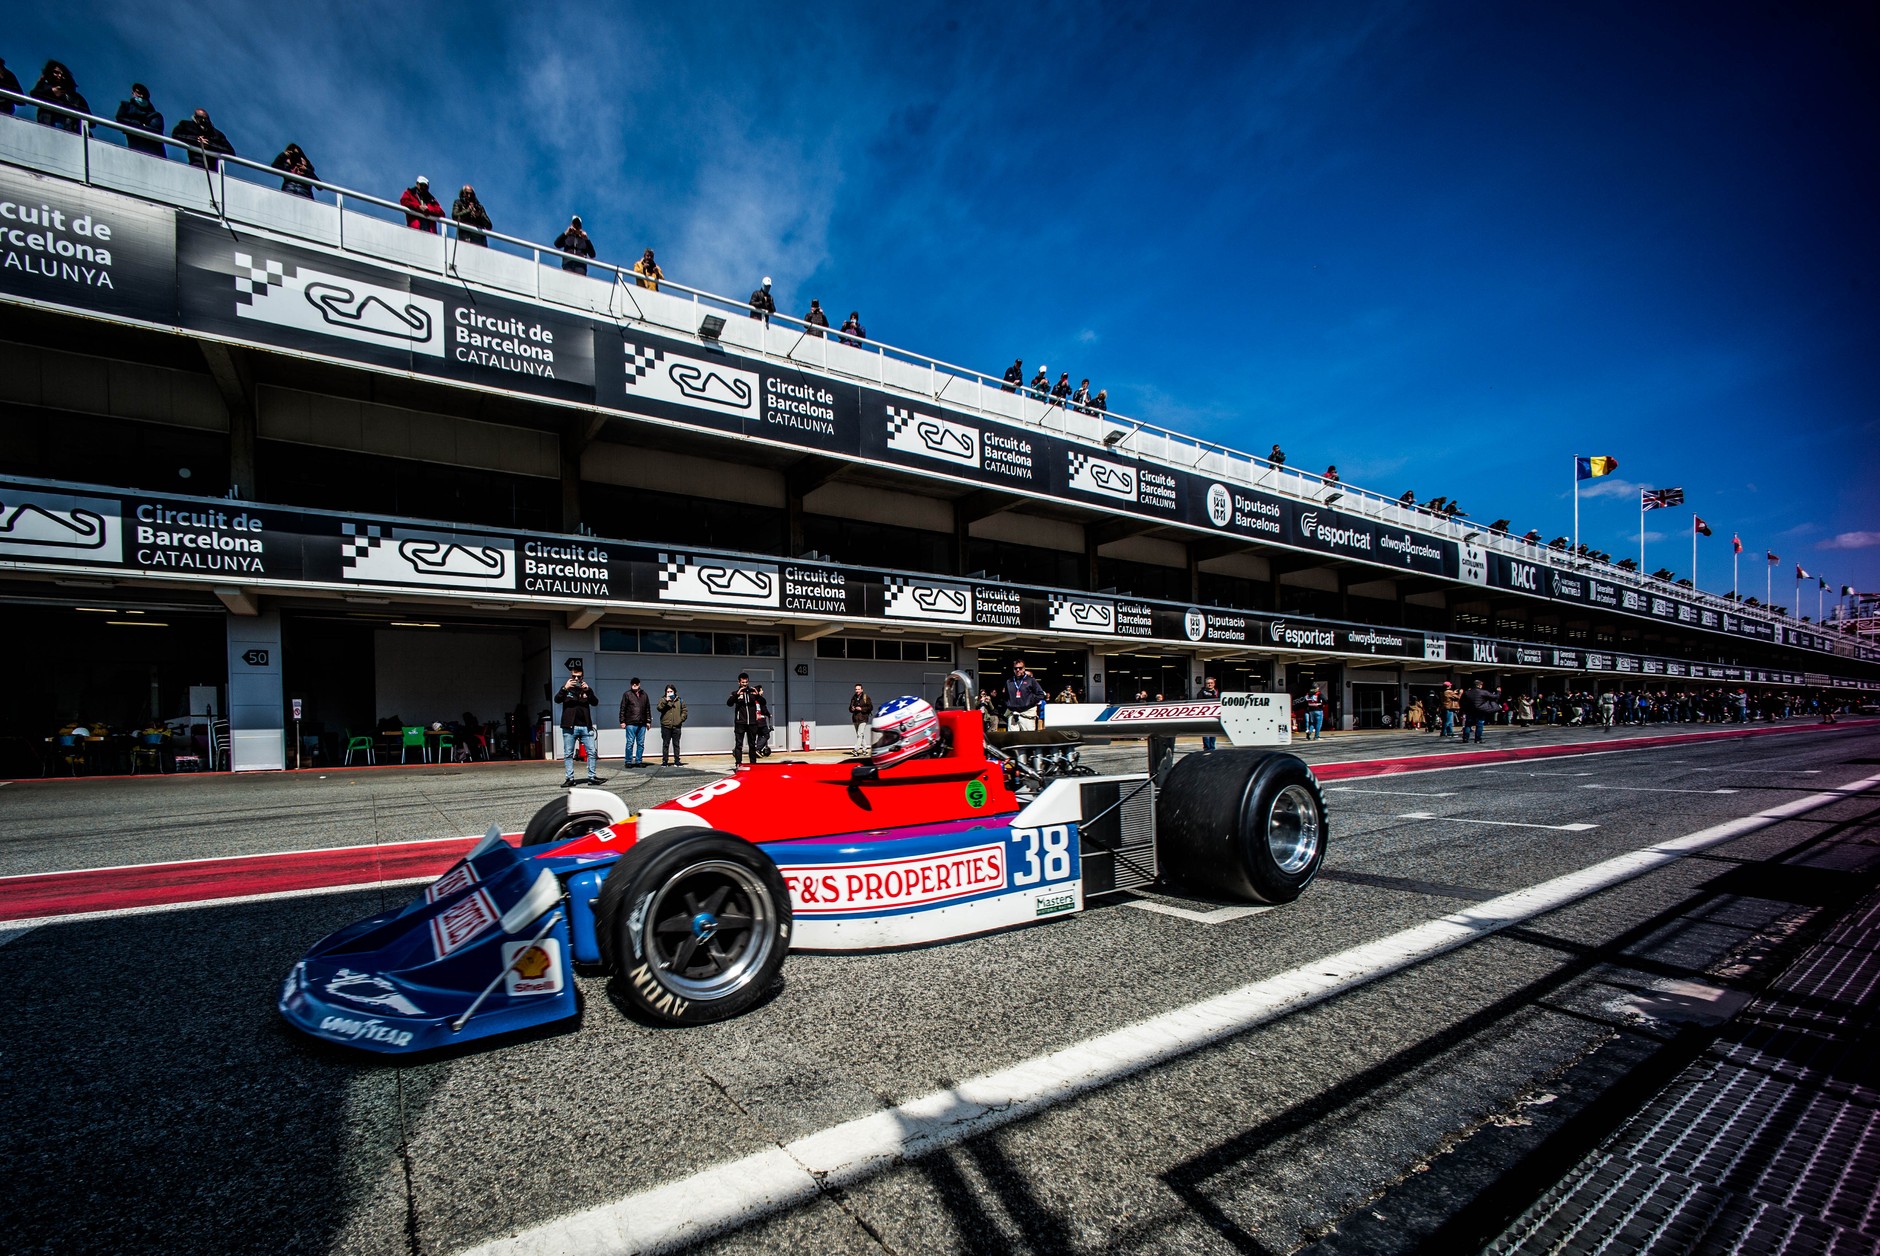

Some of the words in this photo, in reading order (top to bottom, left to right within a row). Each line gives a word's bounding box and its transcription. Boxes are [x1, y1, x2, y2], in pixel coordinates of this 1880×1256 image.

[72, 215, 112, 240] de
[0, 249, 114, 289] ALUNYA
[455, 307, 526, 338] Circuit
[529, 324, 553, 343] de
[456, 326, 554, 362] Barcelona
[456, 347, 555, 379] CATALUNYA
[766, 378, 815, 401] Circuit
[817, 389, 834, 405] de
[767, 394, 834, 420] Barcelona
[767, 411, 835, 435] CATALUNYA
[984, 432, 1019, 451] Circuit
[1019, 440, 1032, 454] de
[985, 445, 1032, 467] Barcelona
[984, 460, 1032, 479] CATALUNYA
[1140, 470, 1166, 486] Circuit
[1166, 476, 1175, 488] de
[1140, 482, 1175, 499] Barcelona
[1140, 494, 1176, 510] CATALUNYA
[1235, 495, 1280, 517] Diputació
[136, 504, 229, 530] Circuit
[232, 513, 263, 533] de
[1235, 512, 1280, 534] Barcelona
[137, 526, 263, 553] Barcelona
[1317, 525, 1371, 550] esportcat
[137, 549, 265, 572] CATALUNYA
[524, 541, 585, 561] Circuit
[587, 547, 608, 563] de
[525, 559, 609, 580] Barcelona
[785, 567, 828, 583] Circuit
[830, 571, 845, 585] de
[1511, 561, 1536, 591] RACC
[525, 577, 609, 595] CATALUNYA
[786, 582, 846, 599] Barcelona
[975, 587, 1008, 601] Circuit
[1008, 590, 1020, 602] de
[786, 597, 846, 612] CATALUNYA
[976, 599, 1021, 614] Barcelona
[1117, 602, 1142, 614] Circuit
[1142, 605, 1151, 615] de
[976, 613, 1021, 625] CATALUNYA
[1118, 614, 1152, 626] Barcelona
[1207, 614, 1245, 627] Diputació
[1118, 625, 1152, 636] CATALUNYA
[1208, 627, 1245, 641] Barcelona
[1285, 629, 1335, 648] esportcat
[249, 652, 267, 664] 50
[1473, 639, 1499, 663] RACC
[797, 665, 808, 675] 48
[1221, 694, 1270, 708] GOODYEAR
[1116, 708, 1146, 719] F&S
[1149, 705, 1221, 718] PROPERT
[969, 790, 984, 801] G
[1012, 826, 1071, 886] 38
[846, 855, 1000, 902] PROPERTIES
[1036, 894, 1074, 908] Masters
